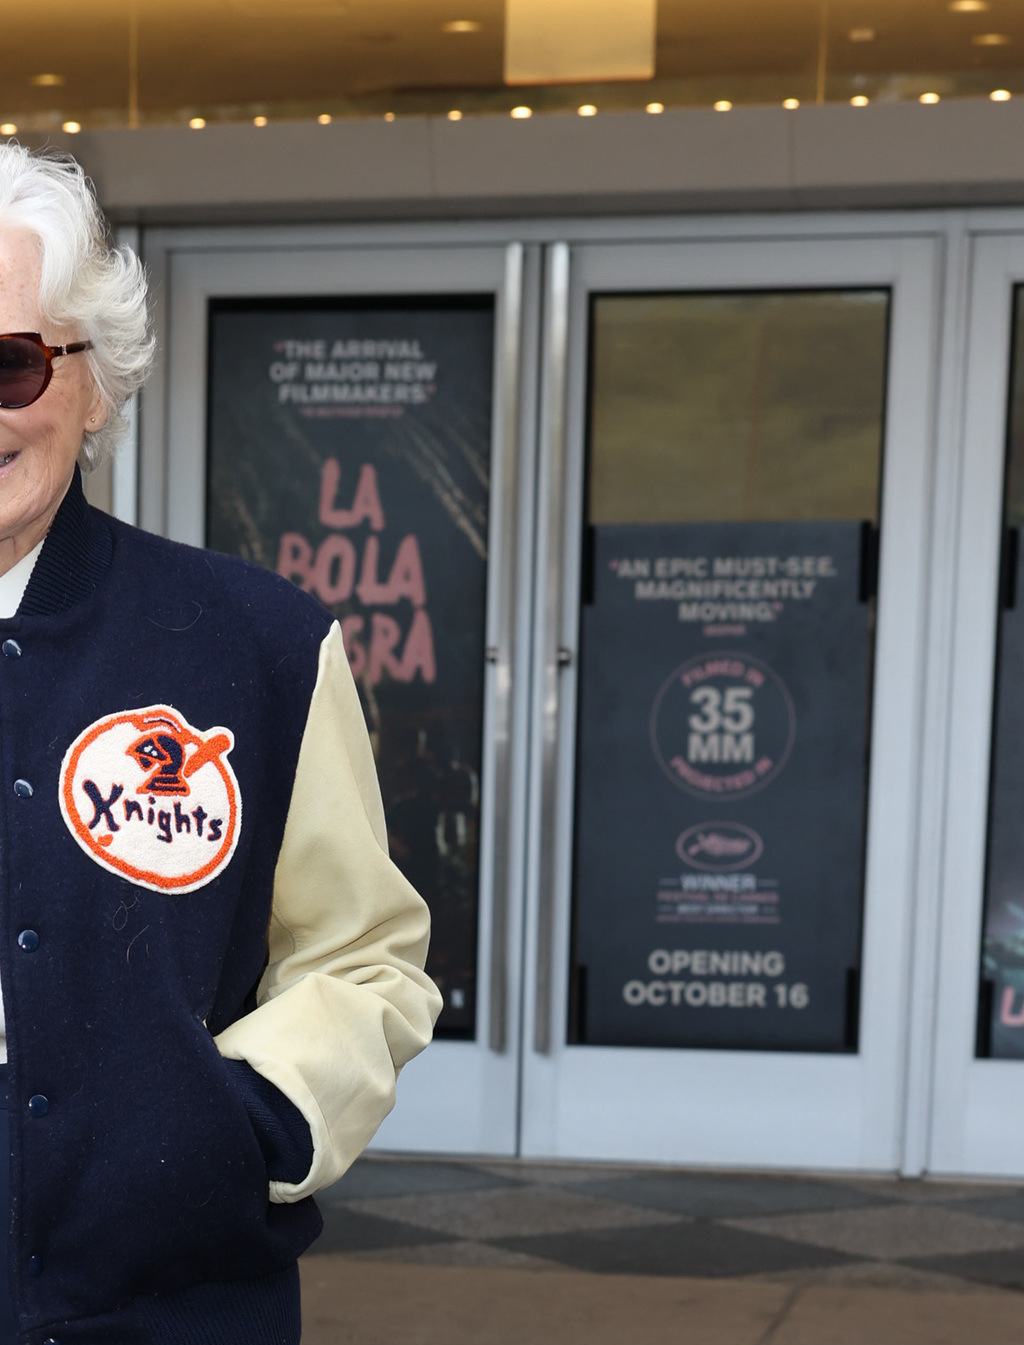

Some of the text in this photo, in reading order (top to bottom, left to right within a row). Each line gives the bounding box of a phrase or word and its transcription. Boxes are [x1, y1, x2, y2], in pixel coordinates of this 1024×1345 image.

[331, 340, 424, 359] ARRIVAL
[269, 362, 437, 381] OF MAJOR NEW
[318, 458, 385, 531] LA
[277, 532, 426, 605] BOLA
[655, 558, 708, 577] EPIC
[635, 580, 816, 599] MAGNIFICENTLY
[689, 686, 754, 733] 35
[688, 733, 754, 763] MM
[82, 779, 223, 843] Knights
[680, 874, 756, 892] WINNER
[648, 949, 785, 977] OPENING
[623, 980, 809, 1009] OCTOBER 16
